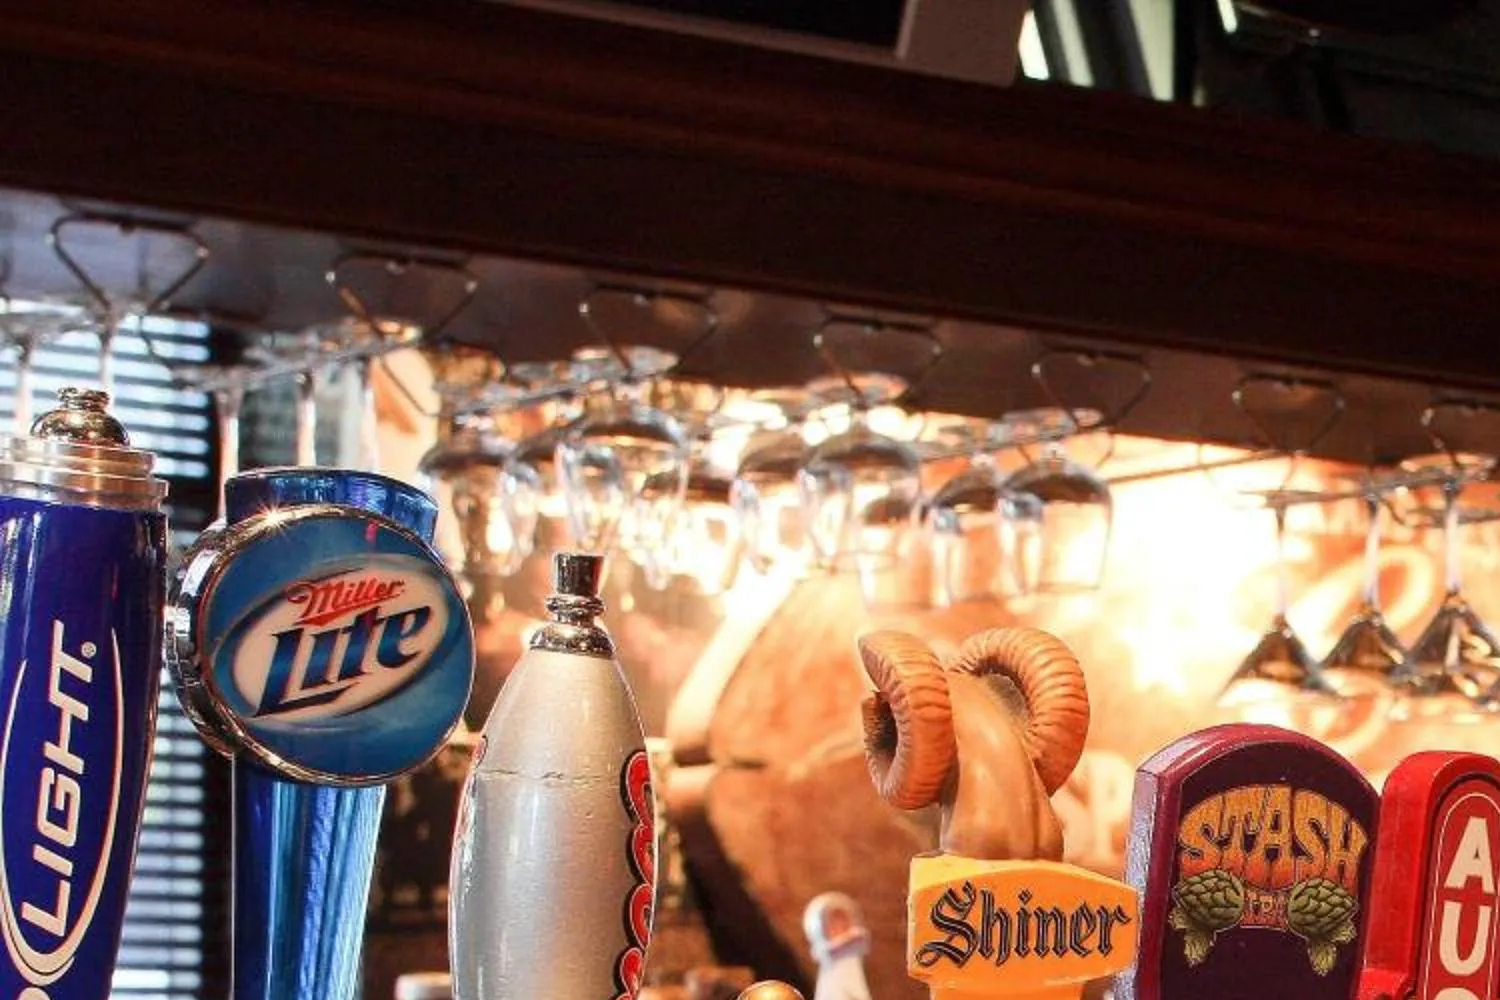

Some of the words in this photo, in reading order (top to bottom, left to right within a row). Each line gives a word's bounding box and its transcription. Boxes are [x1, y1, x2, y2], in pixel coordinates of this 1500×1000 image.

[287, 578, 406, 626] Miller
[250, 605, 432, 718] Lite
[21, 619, 93, 937] LIGHT
[1179, 784, 1369, 891] STASH
[916, 881, 1131, 968] Shiner
